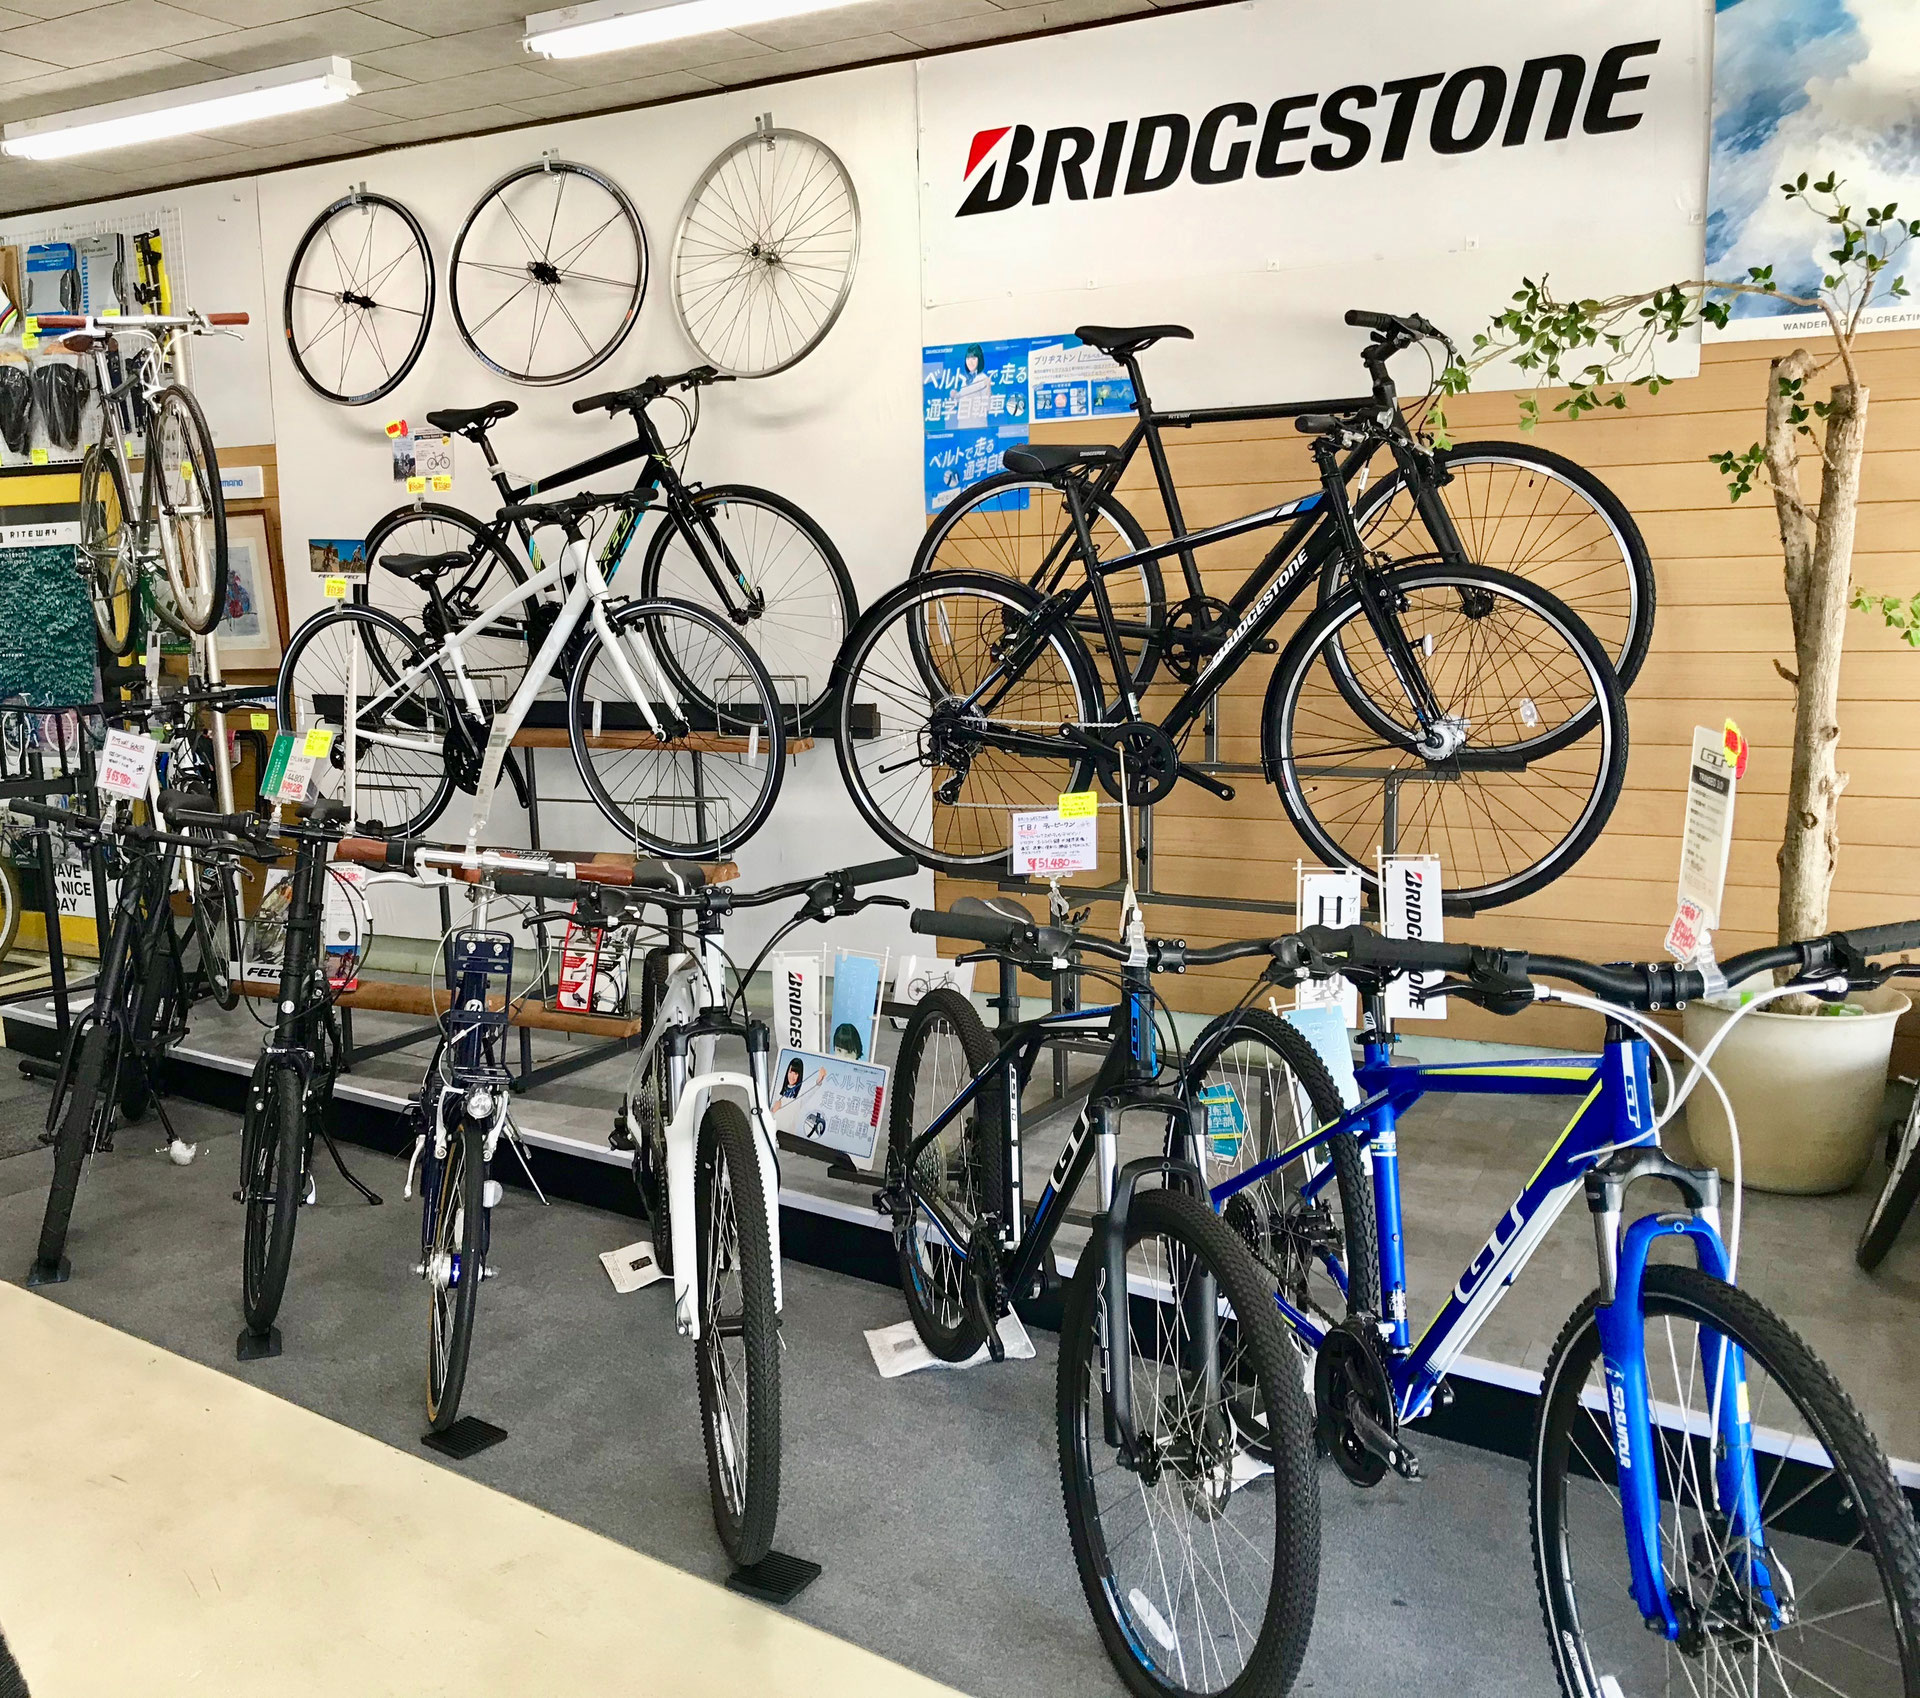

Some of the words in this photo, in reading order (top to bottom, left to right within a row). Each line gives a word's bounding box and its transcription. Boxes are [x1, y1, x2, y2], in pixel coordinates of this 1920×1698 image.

[954, 38, 1662, 217] BRIDGESTONE
[81, 256, 90, 314] HIMANO
[1783, 318, 1848, 331] WANDERIG
[925, 394, 1007, 422] 通学自転車
[929, 437, 995, 469] ベルトで走る
[10, 529, 57, 539] RITEWAY
[1208, 548, 1309, 662] BRIDGESTONE
[61, 880, 92, 897] NICE
[1405, 869, 1425, 1011] BRIDGONE
[1050, 1094, 1091, 1193] GT
[1454, 1188, 1526, 1304] GT
